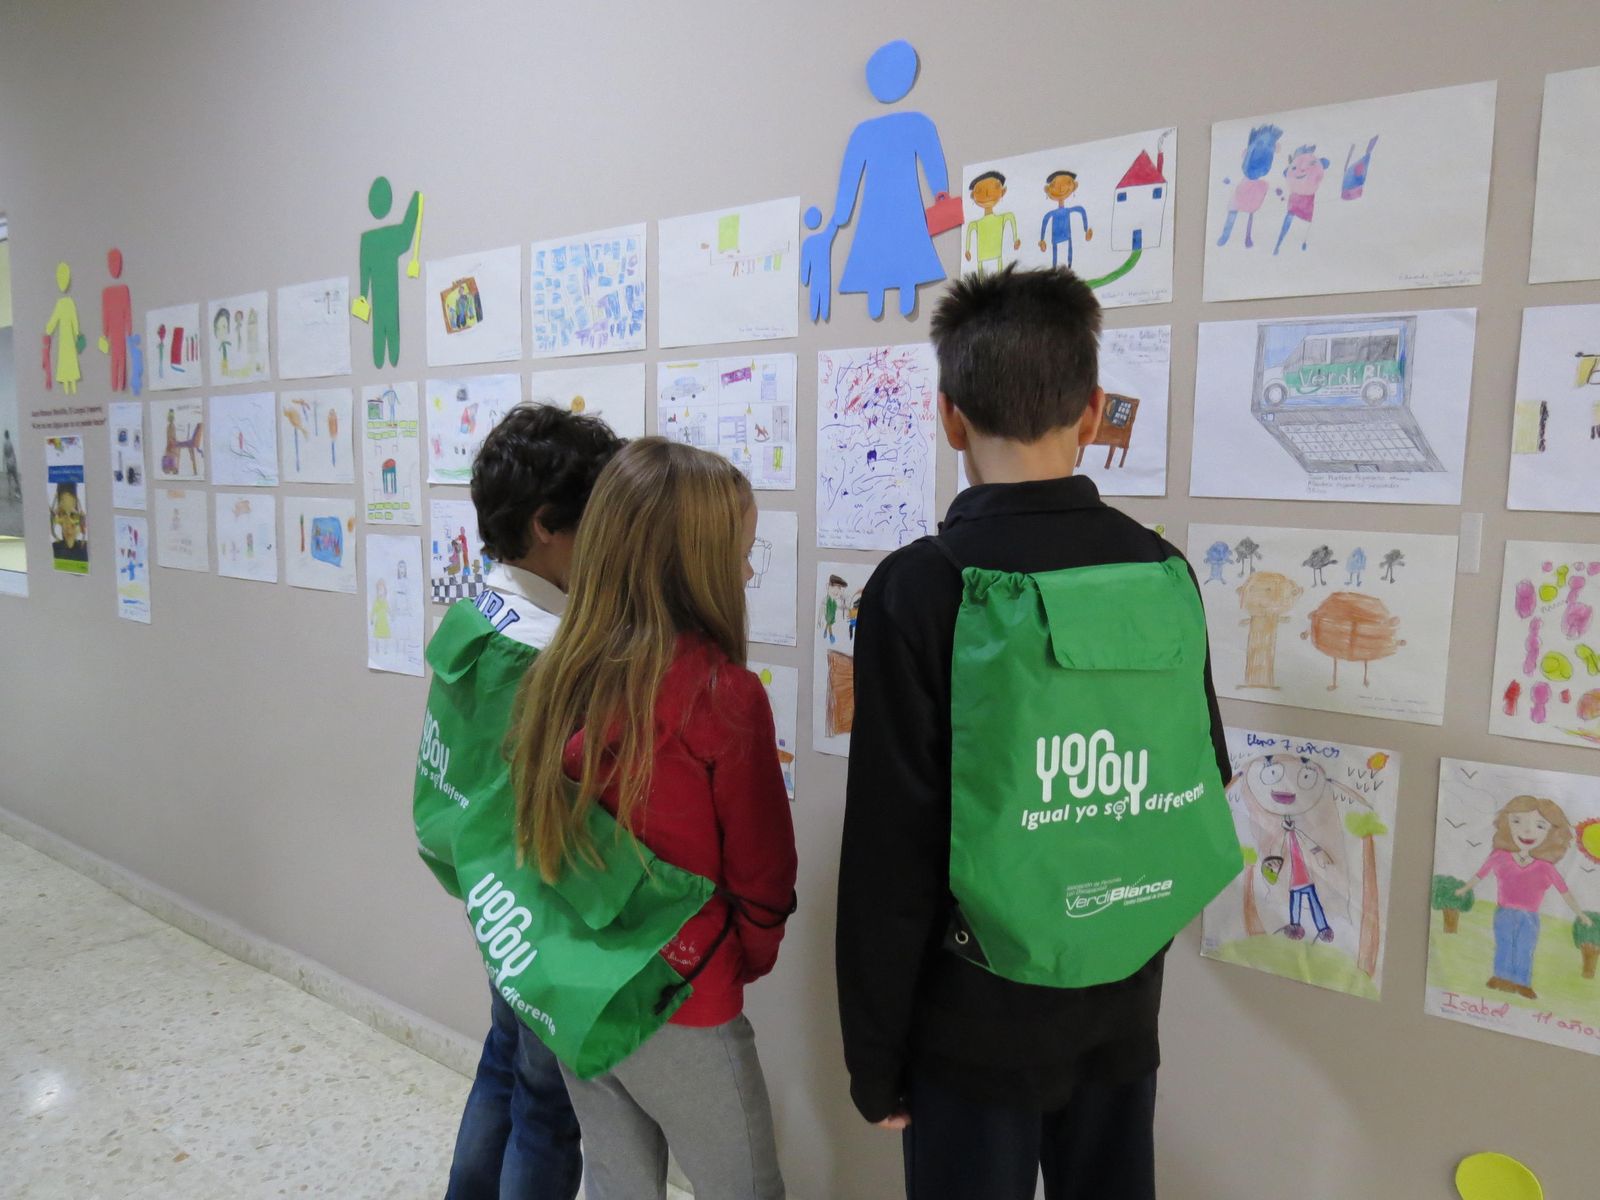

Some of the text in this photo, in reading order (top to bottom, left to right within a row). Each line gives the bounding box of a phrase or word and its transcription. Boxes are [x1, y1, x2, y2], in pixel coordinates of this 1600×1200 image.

[1300, 367, 1358, 386] Verdi
[1281, 739, 1292, 751] 7
[1021, 804, 1070, 830] Igual
[1076, 804, 1098, 823] yo
[1066, 880, 1173, 911] VerdiBlanca
[1441, 991, 1510, 1018] Isabel
